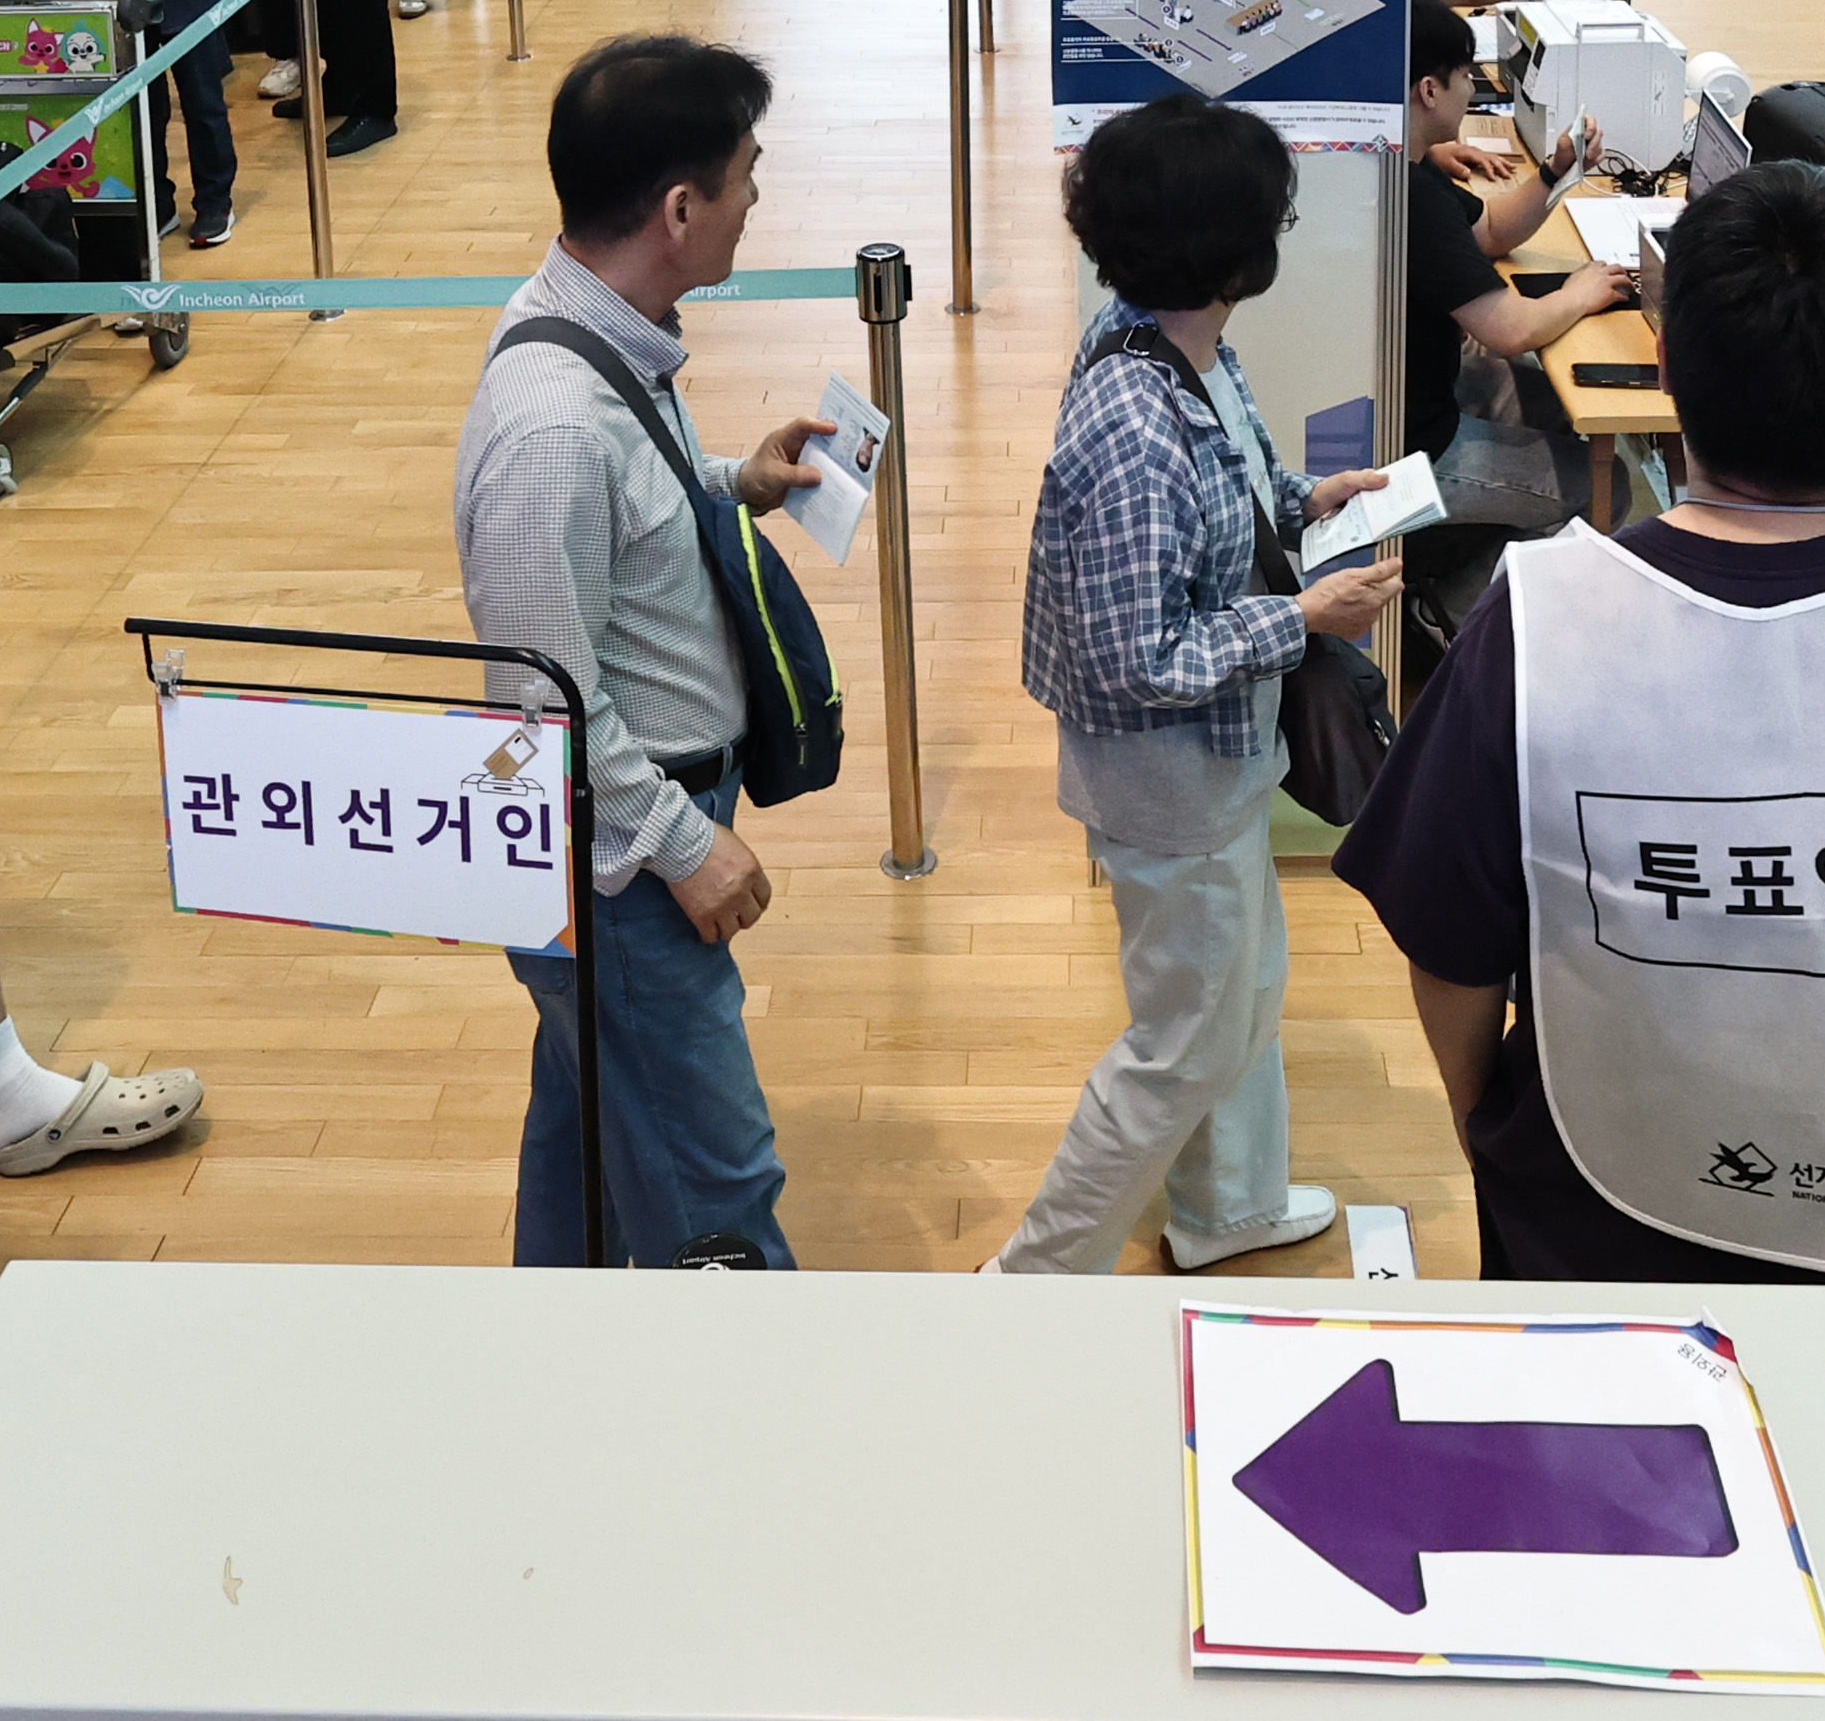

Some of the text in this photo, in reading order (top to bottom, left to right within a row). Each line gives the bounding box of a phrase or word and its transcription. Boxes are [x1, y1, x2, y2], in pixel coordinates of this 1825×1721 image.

[179, 292, 305, 308] Incheon Airport
[182, 773, 553, 870] 관외선거인
